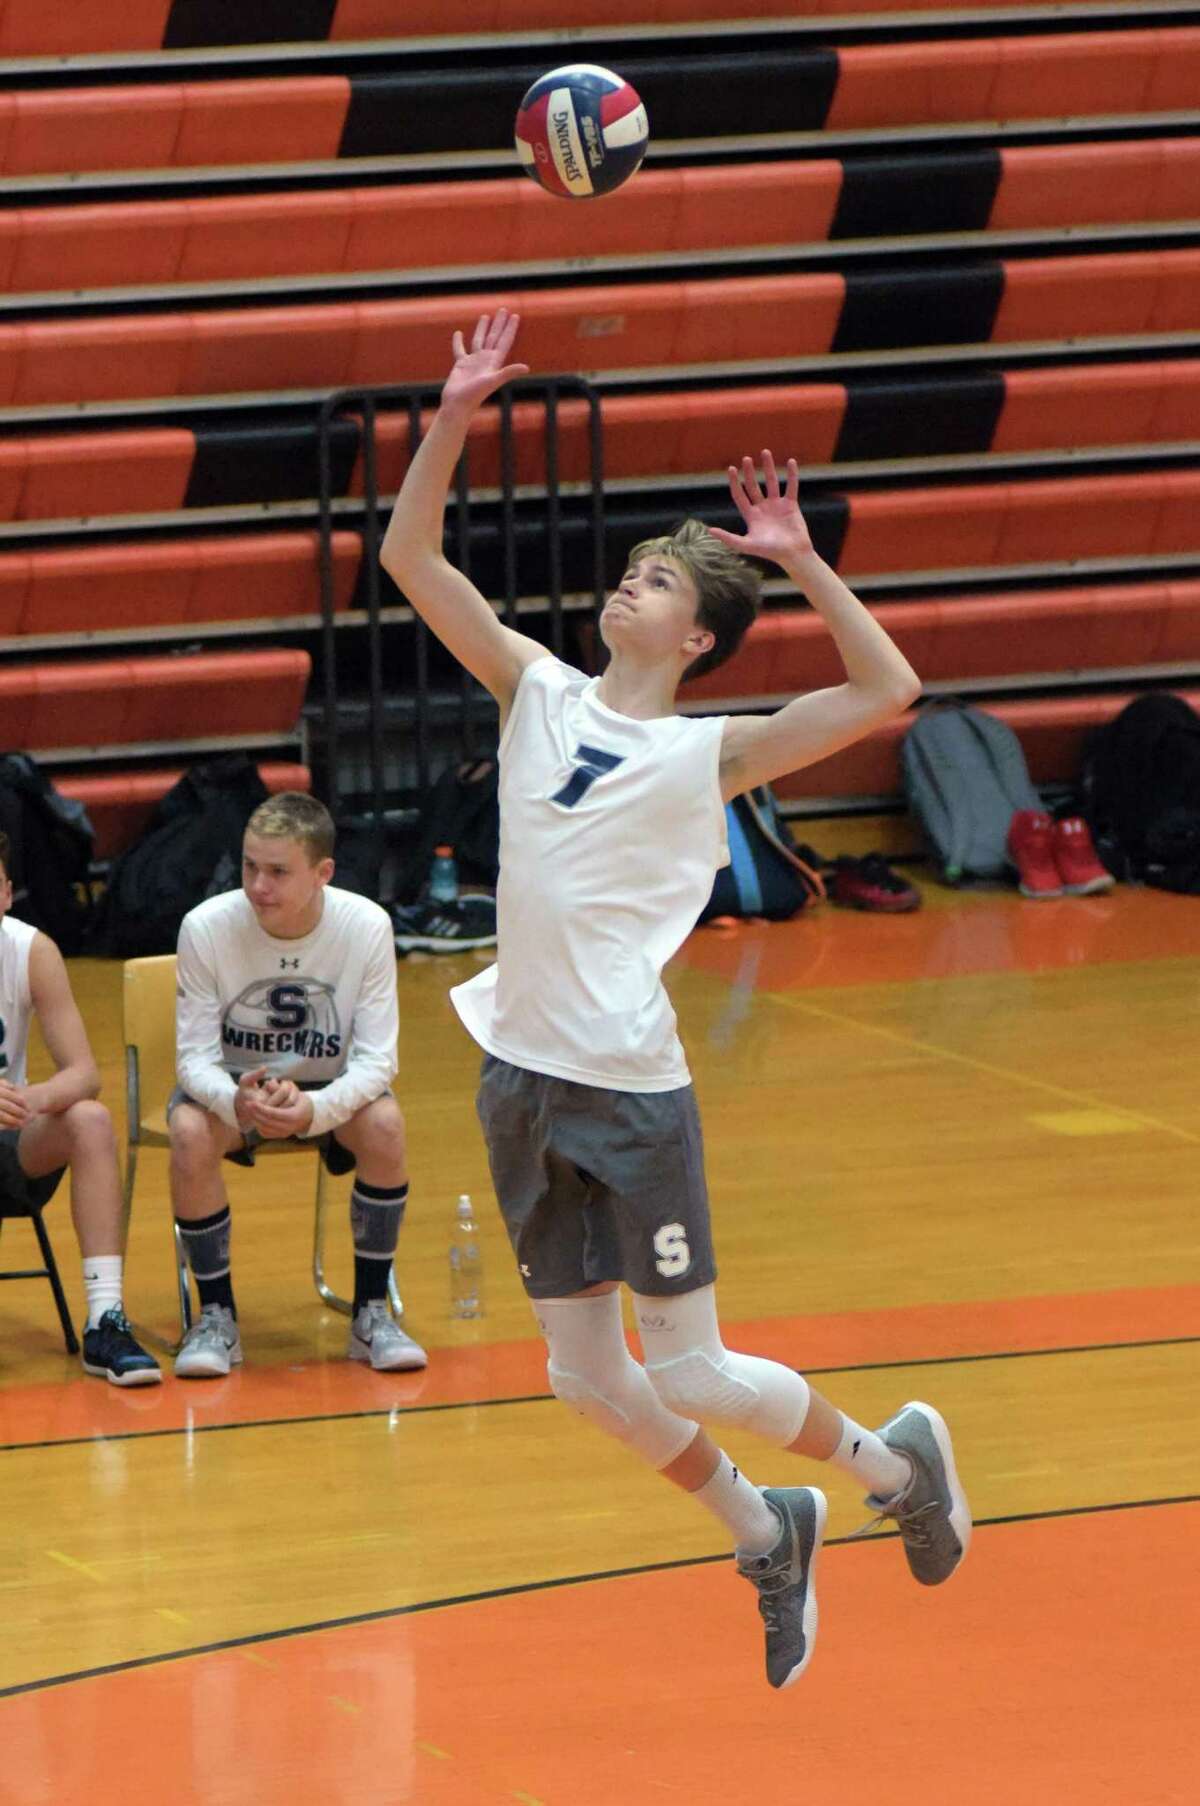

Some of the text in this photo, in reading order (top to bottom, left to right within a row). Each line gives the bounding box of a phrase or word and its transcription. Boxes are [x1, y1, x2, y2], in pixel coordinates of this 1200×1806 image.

[552, 111, 582, 182] SPALDING
[551, 744, 626, 808] 7
[267, 982, 307, 1029] S
[654, 1222, 690, 1278] S
